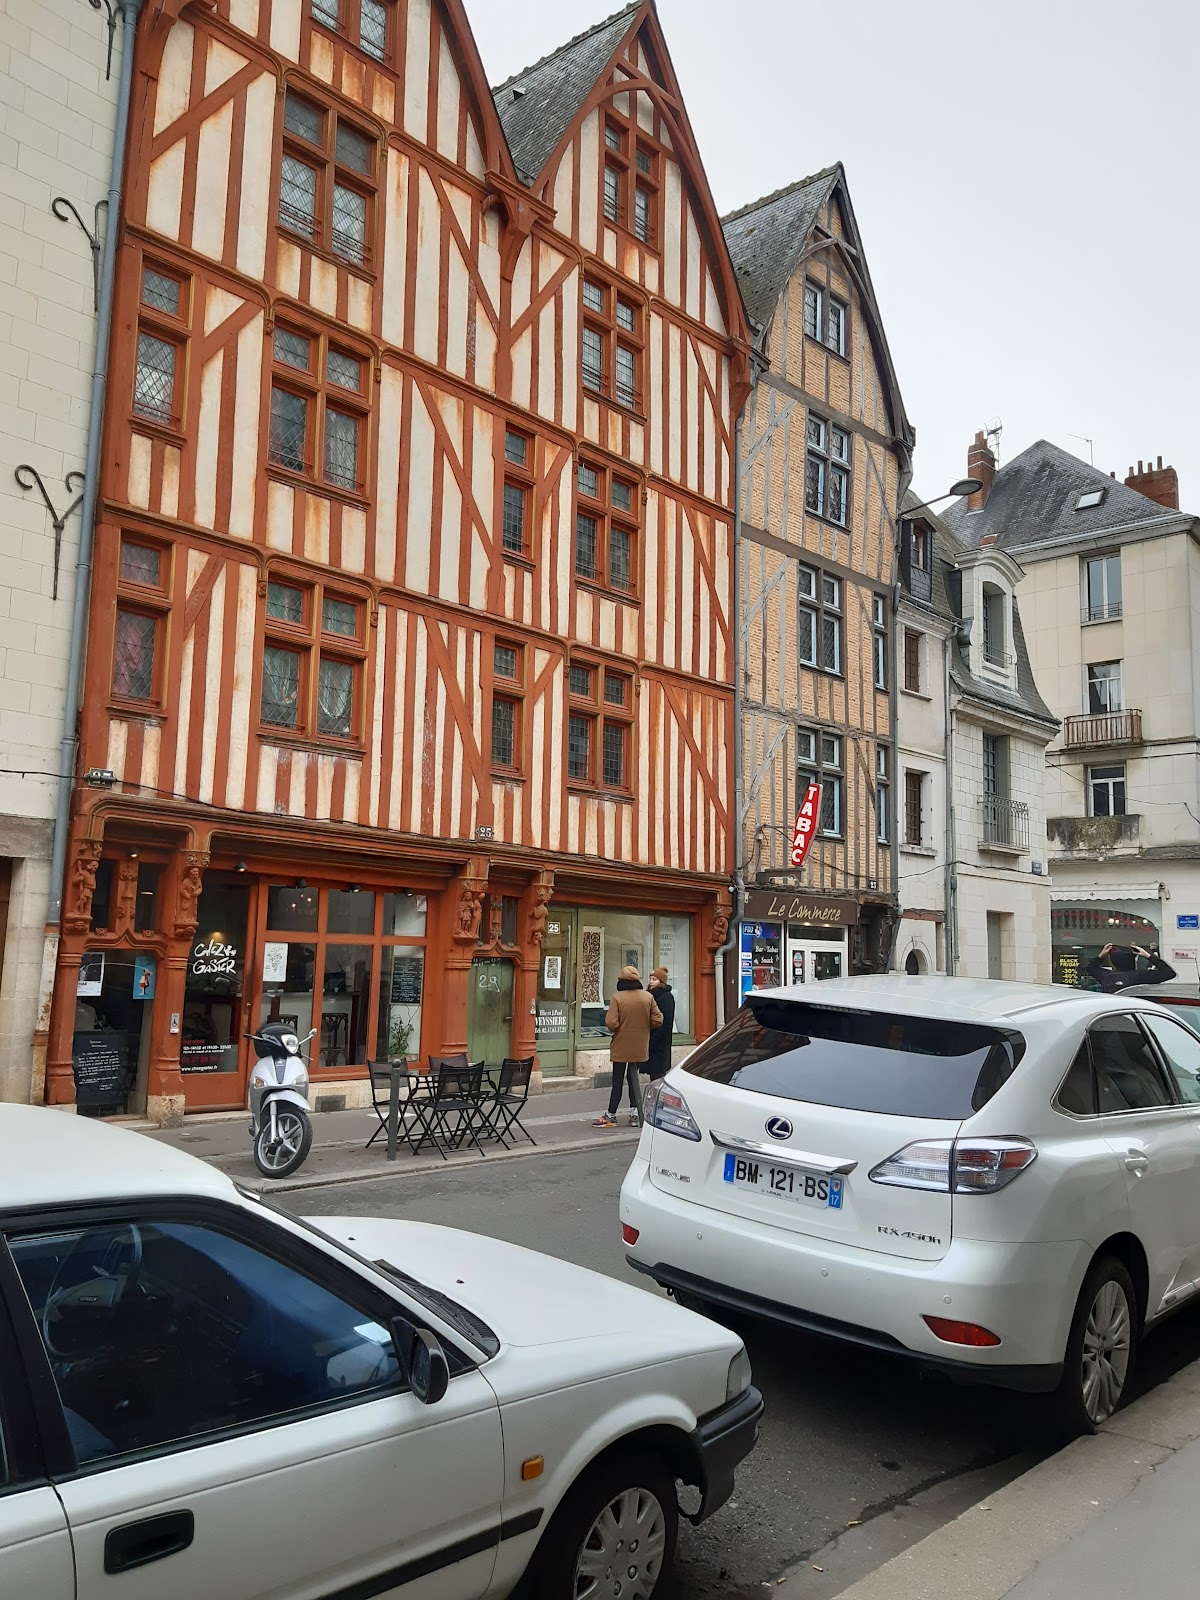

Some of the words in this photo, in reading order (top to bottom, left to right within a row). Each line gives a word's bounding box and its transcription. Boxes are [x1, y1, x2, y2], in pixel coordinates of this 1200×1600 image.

[792, 786, 817, 863] TABAC
[479, 826, 492, 838] 25
[768, 896, 786, 917] Le
[788, 897, 841, 922] Commerce
[548, 923, 559, 933] 25
[194, 938, 225, 957] CHEZ
[193, 957, 237, 974] GASTER
[761, 956, 774, 964] Snack
[830, 1194, 840, 1205] 17
